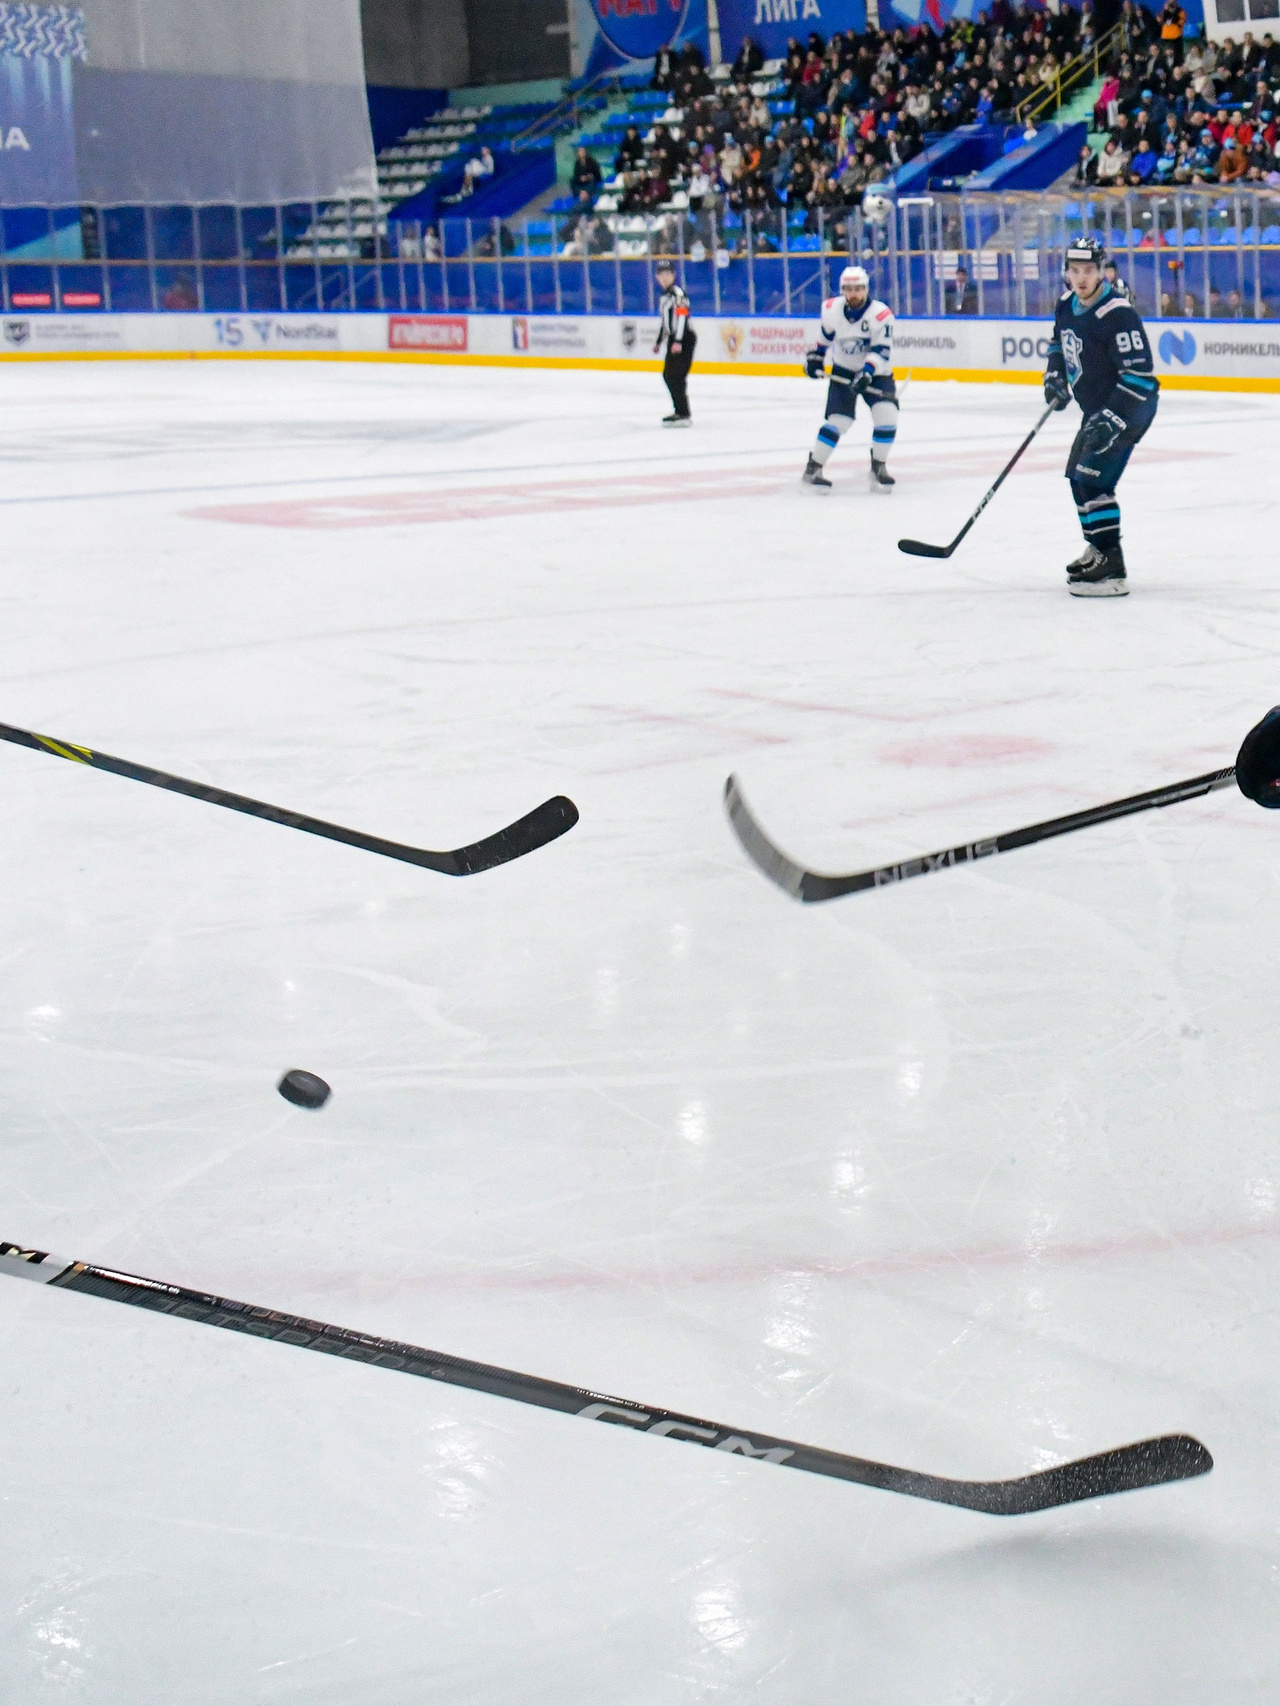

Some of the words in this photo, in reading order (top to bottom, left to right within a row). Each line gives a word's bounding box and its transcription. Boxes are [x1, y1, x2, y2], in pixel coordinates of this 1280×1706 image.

[893, 338, 956, 350] НОРНИКЕЛЬ
[1116, 331, 1143, 352] 96
[575, 1403, 795, 1465] CCM
